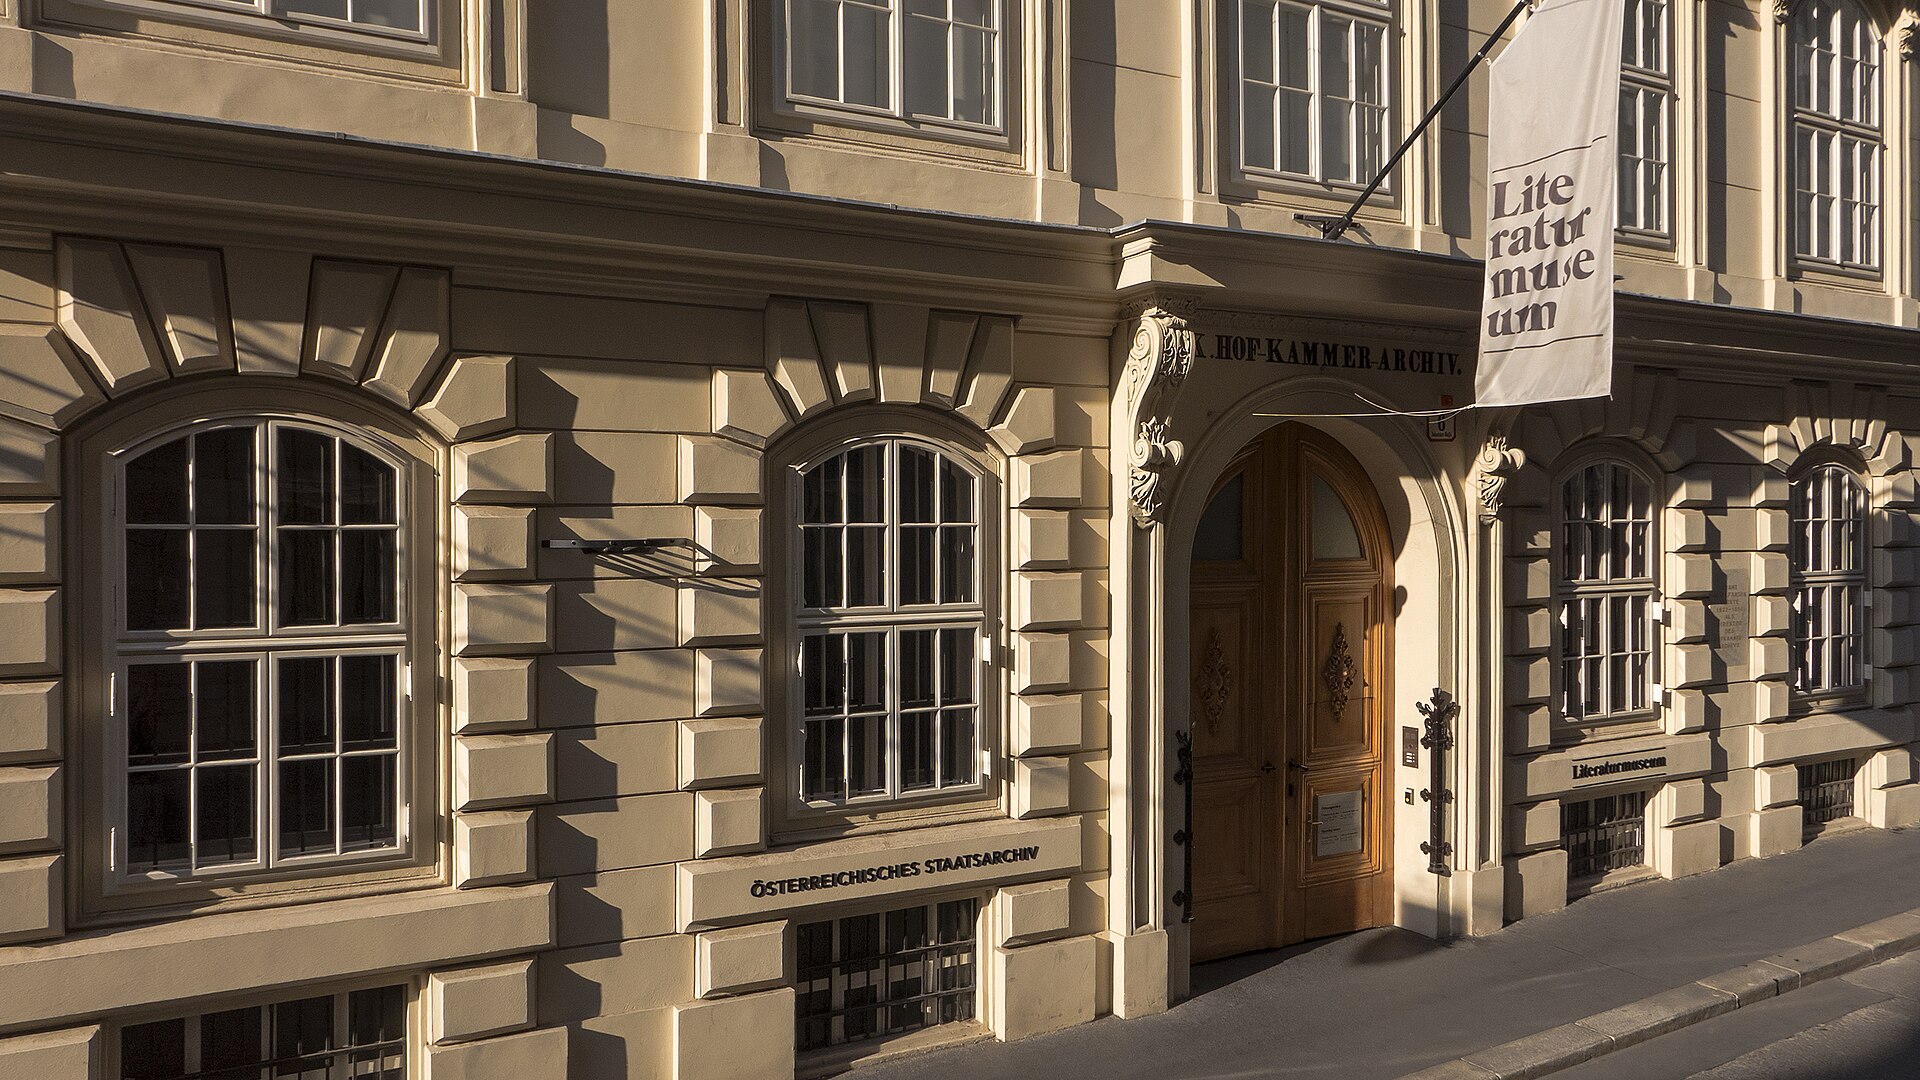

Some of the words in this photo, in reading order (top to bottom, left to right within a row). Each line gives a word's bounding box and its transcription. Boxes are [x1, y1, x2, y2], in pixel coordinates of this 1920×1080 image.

[1491, 171, 1574, 220] Lite
[1490, 207, 1591, 260] ratur
[1490, 249, 1595, 299] muse
[1487, 301, 1557, 338] um
[1572, 756, 1667, 780] Literaturmuseum
[750, 861, 921, 898] ÖSTERREICHISCHES
[924, 846, 1040, 875] STAATSARCHIV
